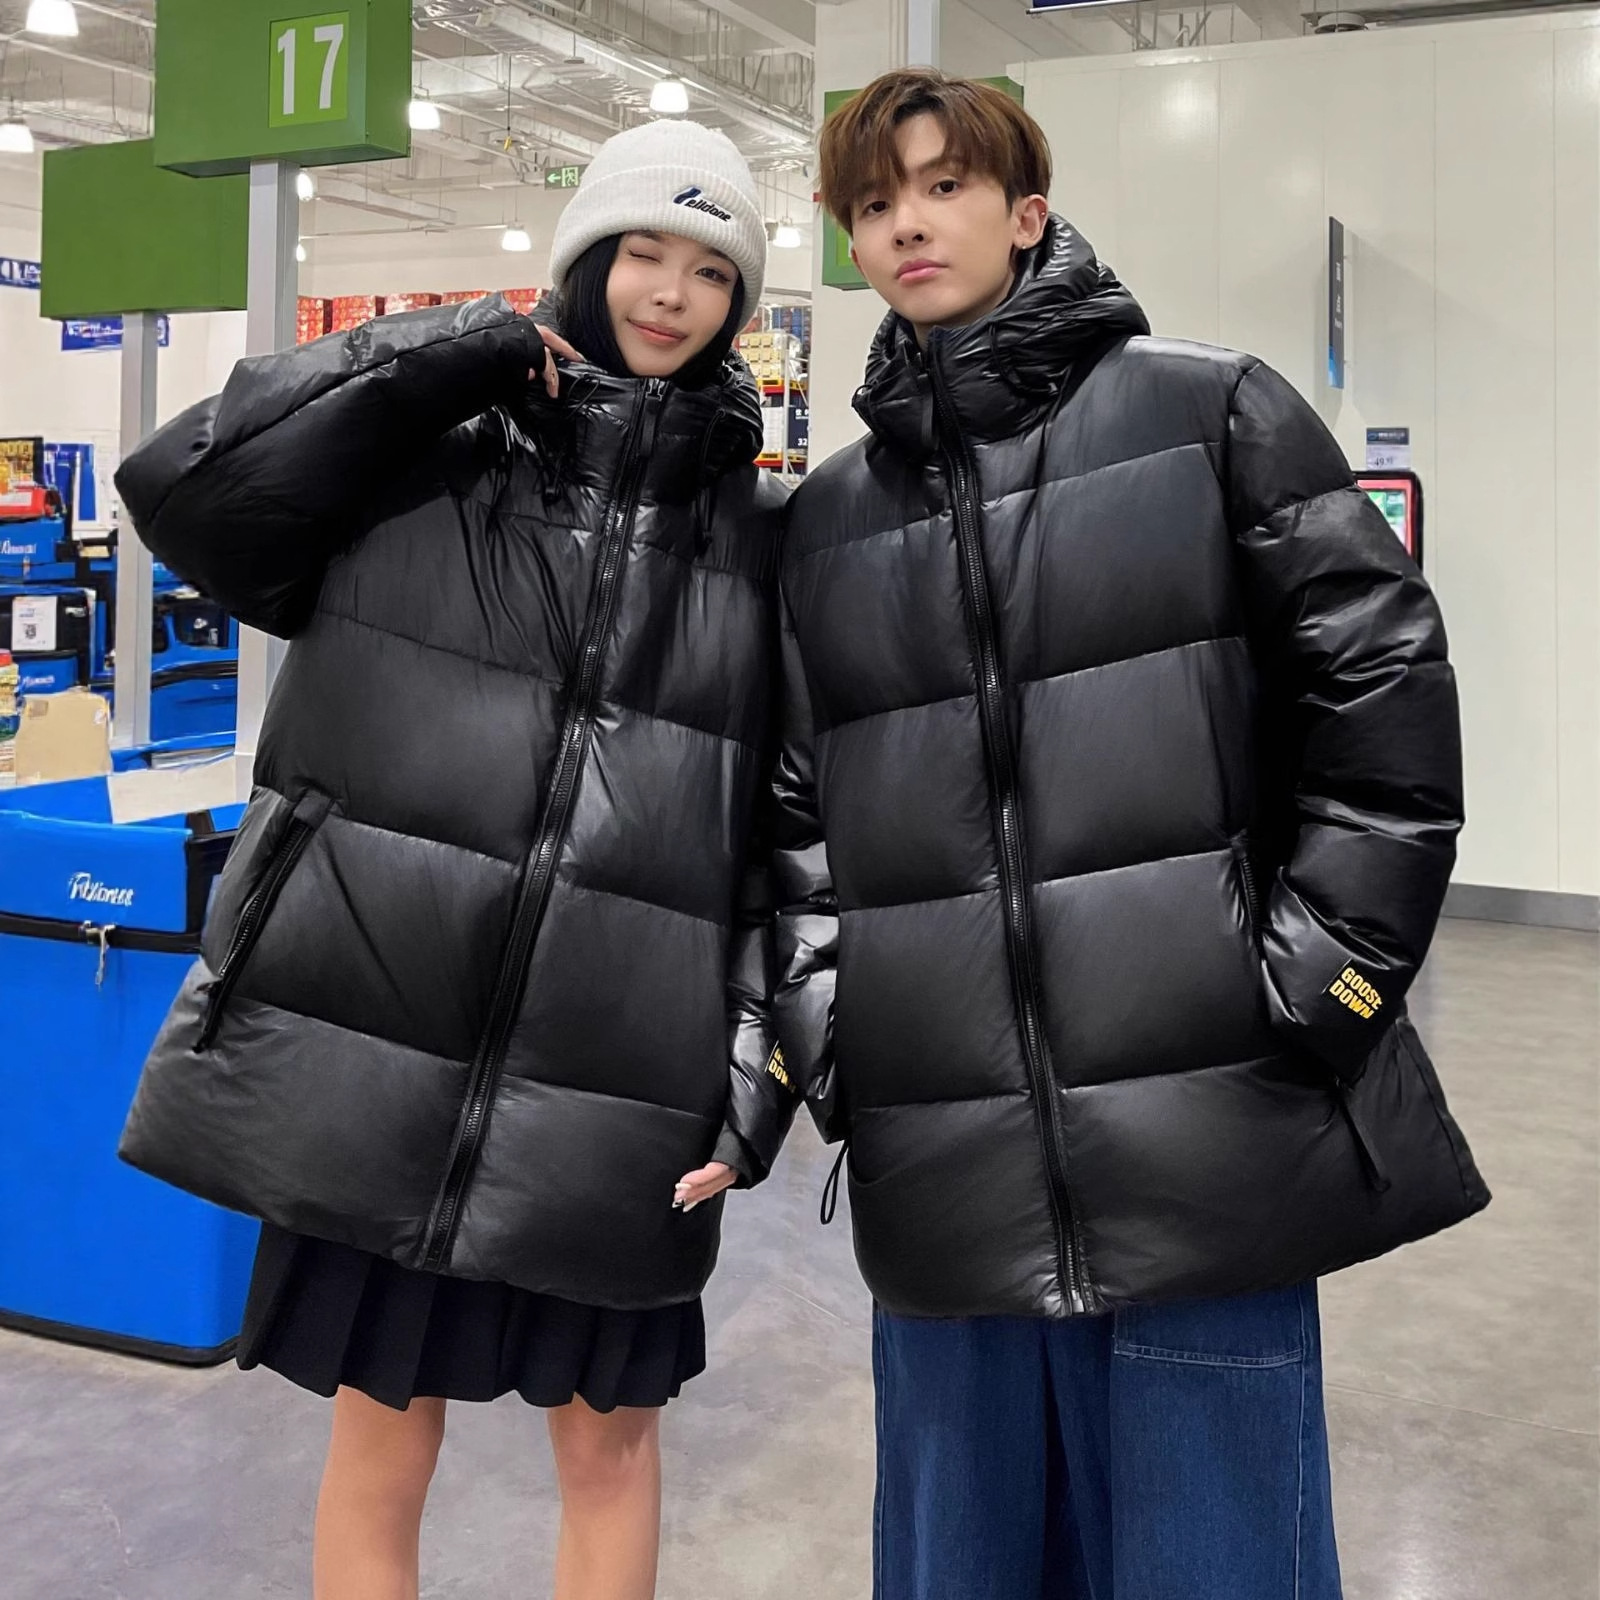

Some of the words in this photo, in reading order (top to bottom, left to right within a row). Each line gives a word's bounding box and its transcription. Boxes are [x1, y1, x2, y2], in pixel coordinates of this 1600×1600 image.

[277, 23, 344, 115] 17
[1329, 979, 1375, 1019] DOWN
[1341, 967, 1383, 1010] GOOSE
